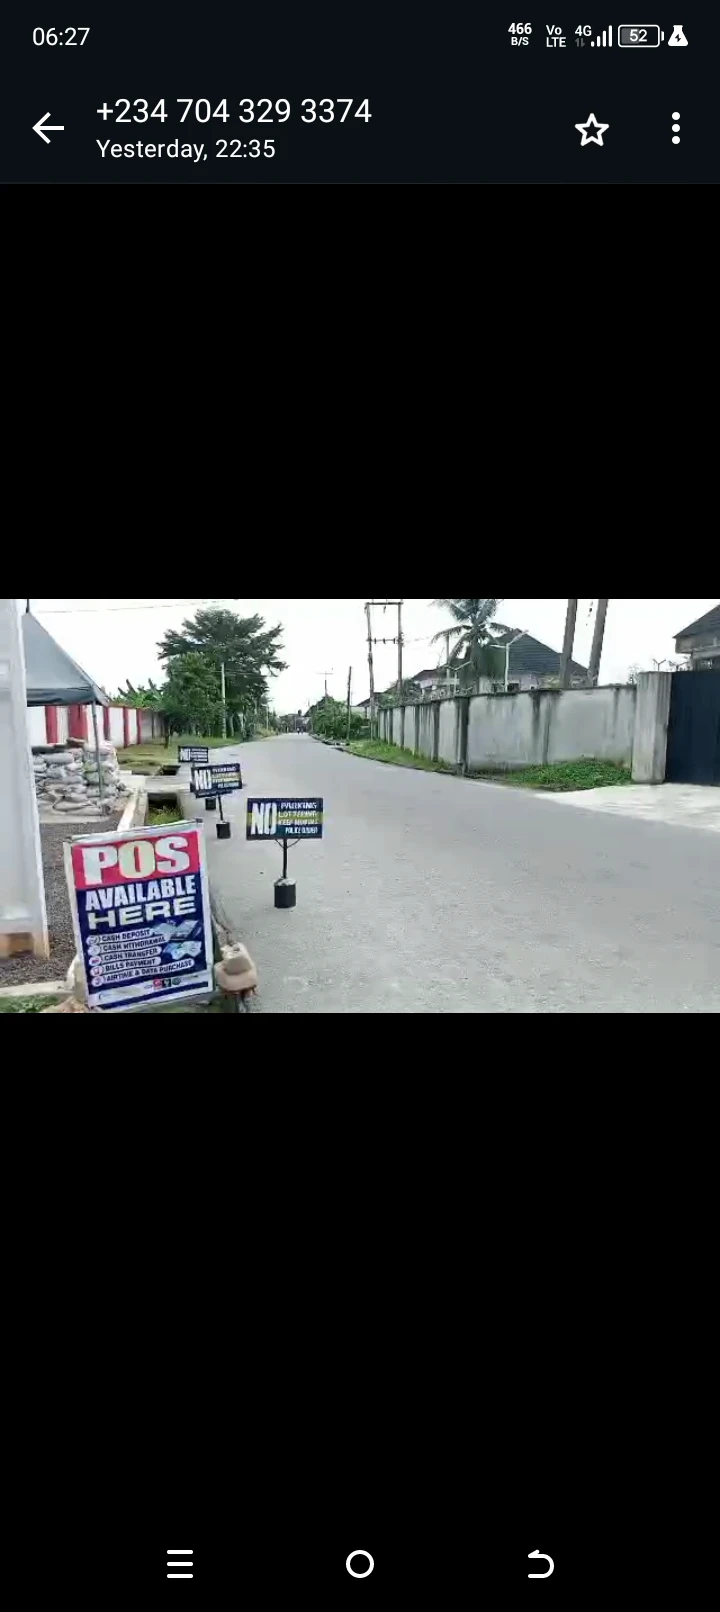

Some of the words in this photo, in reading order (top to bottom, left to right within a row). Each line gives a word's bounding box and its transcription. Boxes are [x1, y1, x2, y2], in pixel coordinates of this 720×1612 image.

[194, 769, 212, 790] NO
[251, 802, 277, 835] NO
[82, 836, 190, 885] POS
[86, 875, 196, 911] AVAILABLE
[88, 897, 196, 930] HERE
[101, 934, 120, 942] CASH
[122, 929, 151, 940] DEPOSIT
[103, 943, 122, 951] CASH
[123, 936, 165, 949] WITHDRAWAL
[104, 953, 123, 961] CASH
[125, 947, 159, 958] TRANSFER
[105, 963, 124, 971] BILLS
[125, 958, 156, 968] PAYMENT
[141, 966, 158, 974] DATA
[159, 960, 192, 972] PURCHASE
